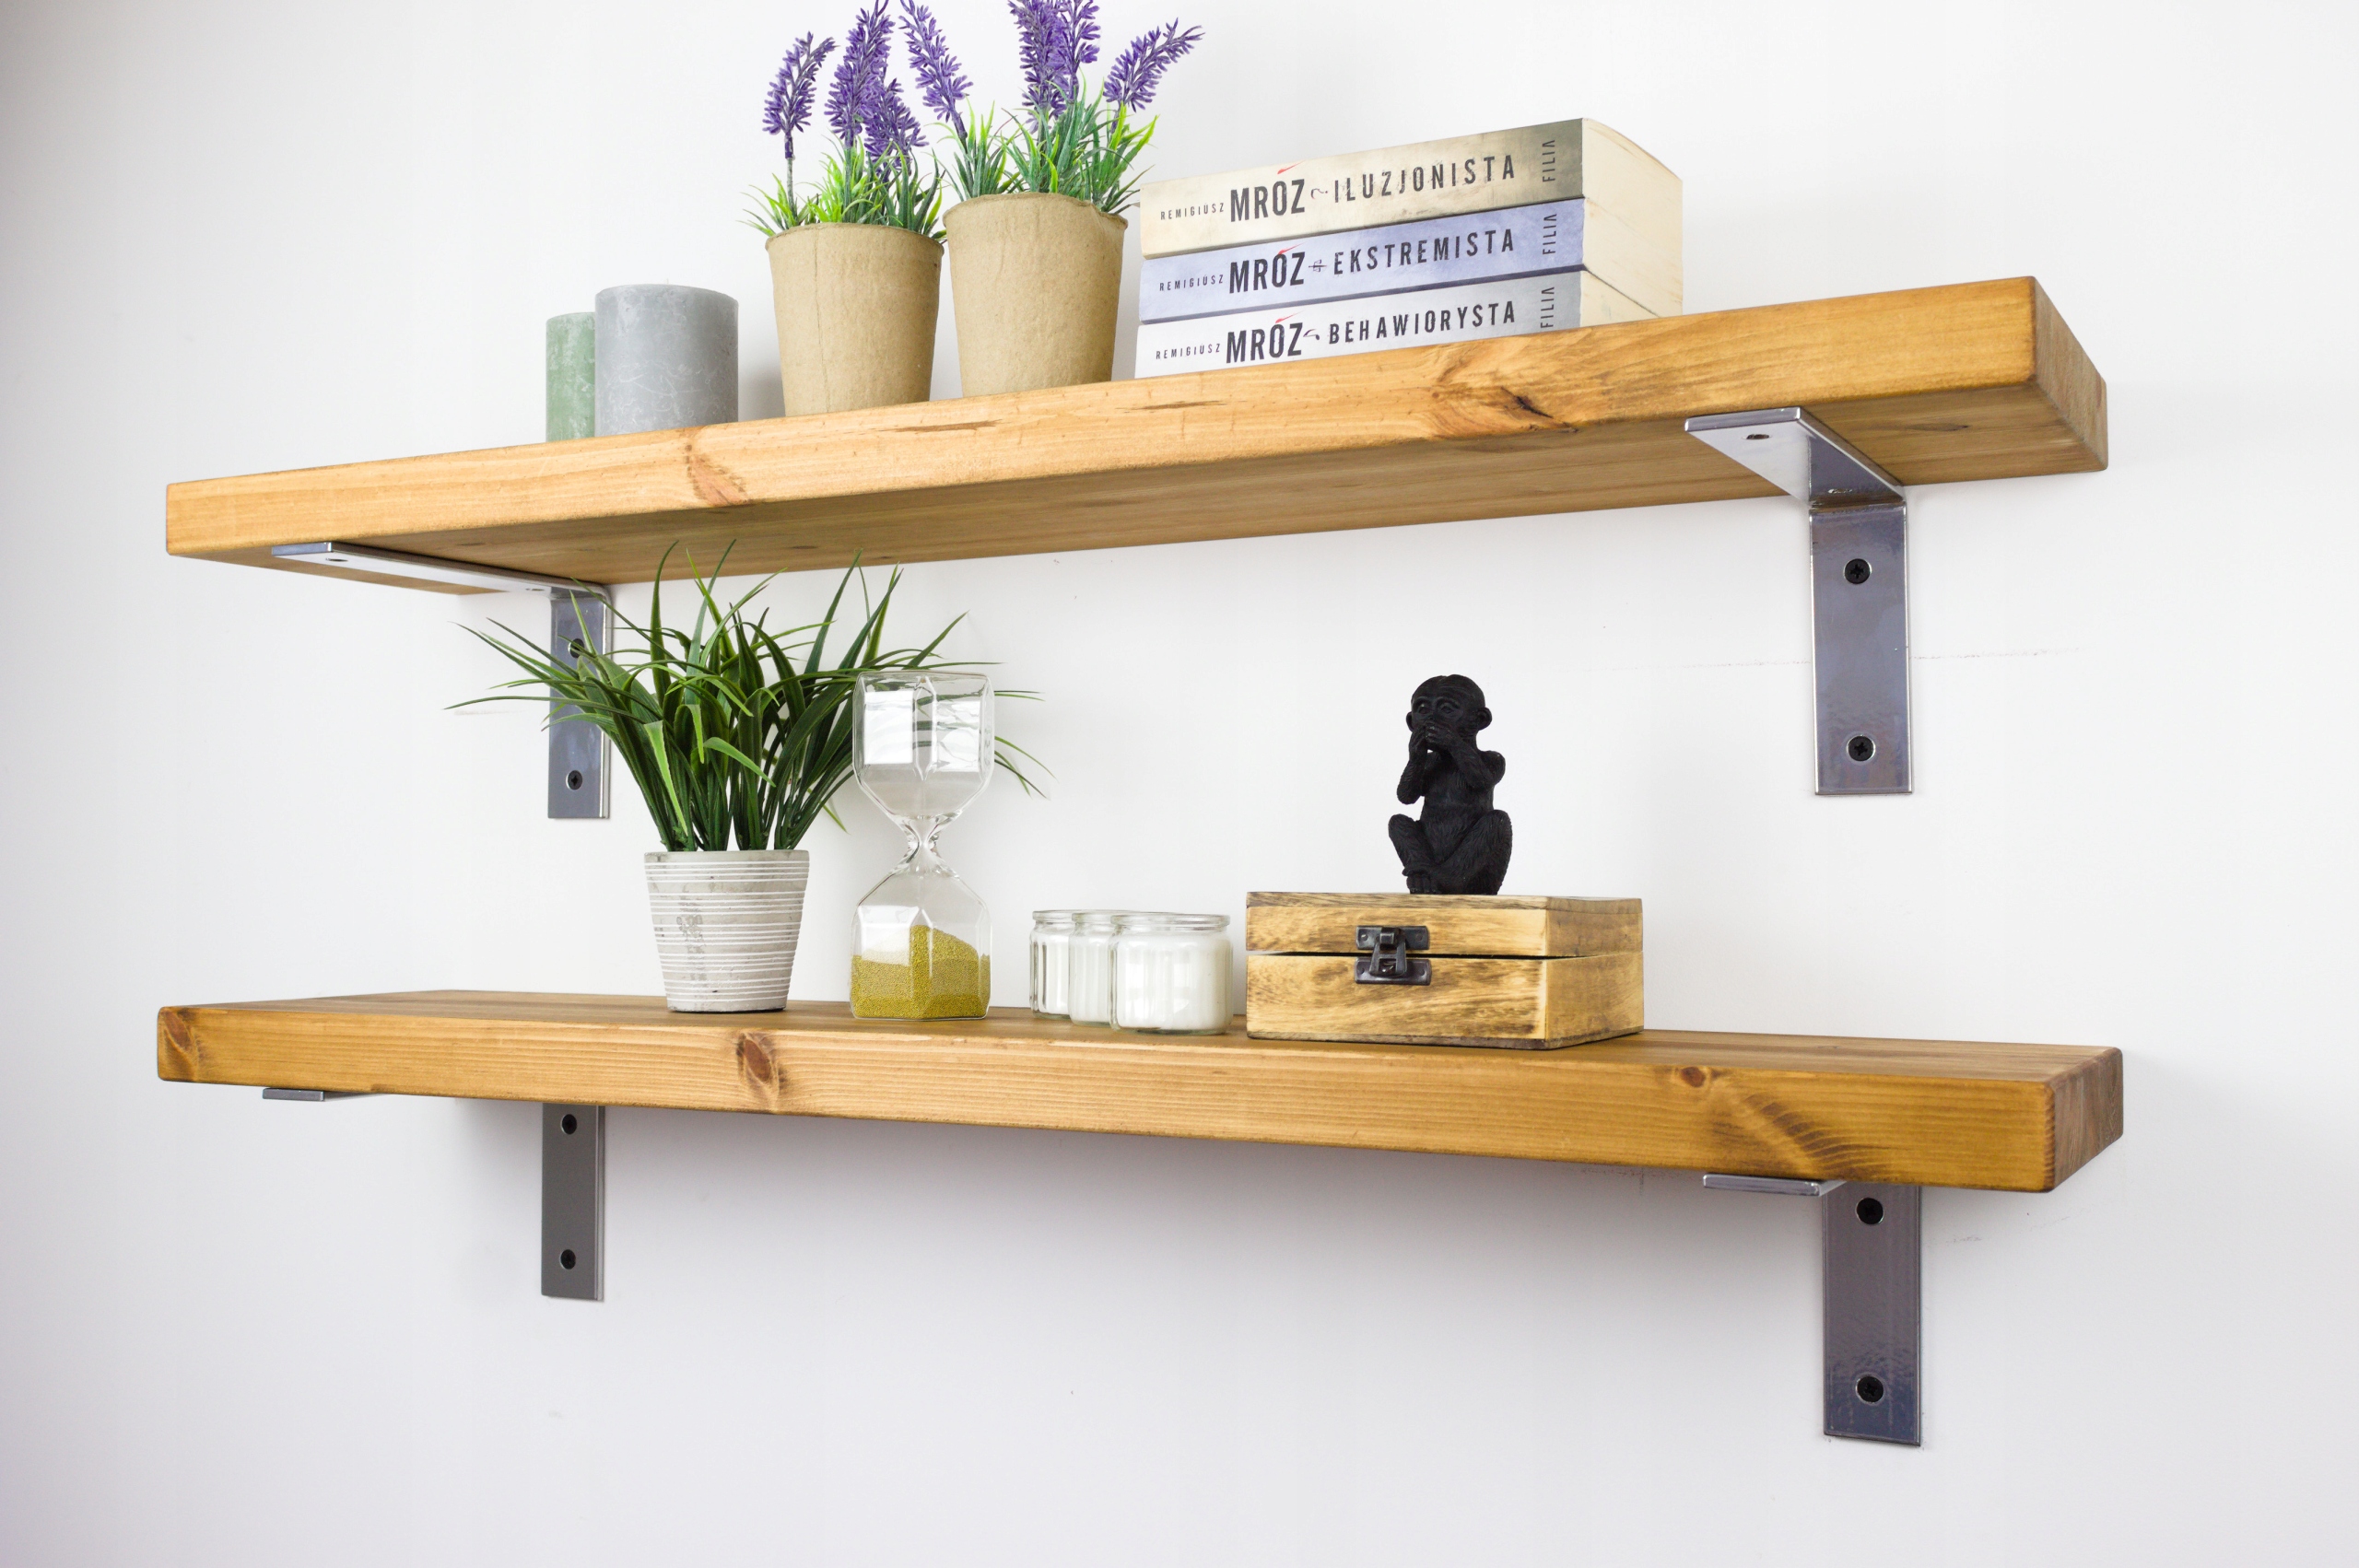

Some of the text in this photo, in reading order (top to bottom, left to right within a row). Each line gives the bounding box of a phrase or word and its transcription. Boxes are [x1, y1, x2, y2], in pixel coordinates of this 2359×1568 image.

[1542, 139, 1555, 182] FILIA
[1230, 160, 1307, 222] MRÓZ
[1334, 155, 1515, 203] ILUZJONISTA
[1229, 243, 1306, 294] MRÓZ
[1333, 228, 1514, 275] EKSTREMISTA
[1542, 214, 1557, 255] FILIA
[1226, 311, 1304, 364] MRÓZ
[1329, 301, 1515, 345] BEHAWIORYSTA
[1540, 287, 1555, 329] FILIA
